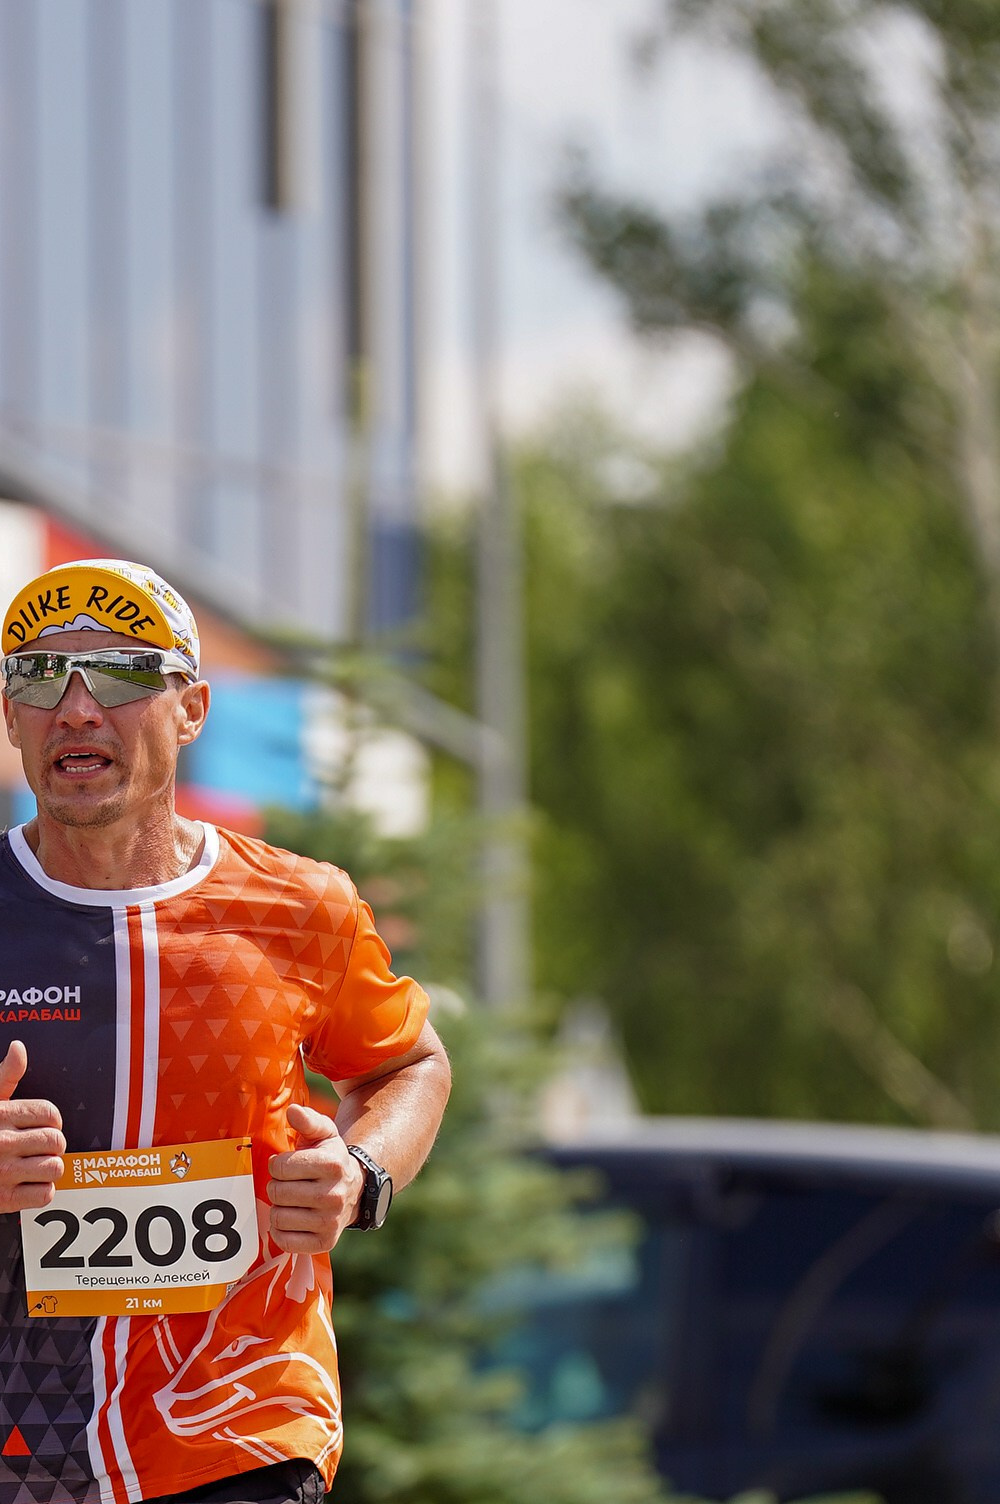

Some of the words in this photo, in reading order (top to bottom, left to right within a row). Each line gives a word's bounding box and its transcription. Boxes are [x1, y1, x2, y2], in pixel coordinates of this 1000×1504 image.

[7, 585, 71, 643] DIIKE
[86, 585, 156, 635] RIDE
[83, 1153, 161, 1169] МАРАФОН
[73, 1159, 82, 1183] 2026
[109, 1167, 161, 1178] КАРАБАШ
[34, 1199, 242, 1269] 2208
[75, 1274, 150, 1287] Терещенко
[153, 1269, 210, 1284] Алексей
[125, 1297, 139, 1309] 21
[143, 1298, 162, 1308] км
